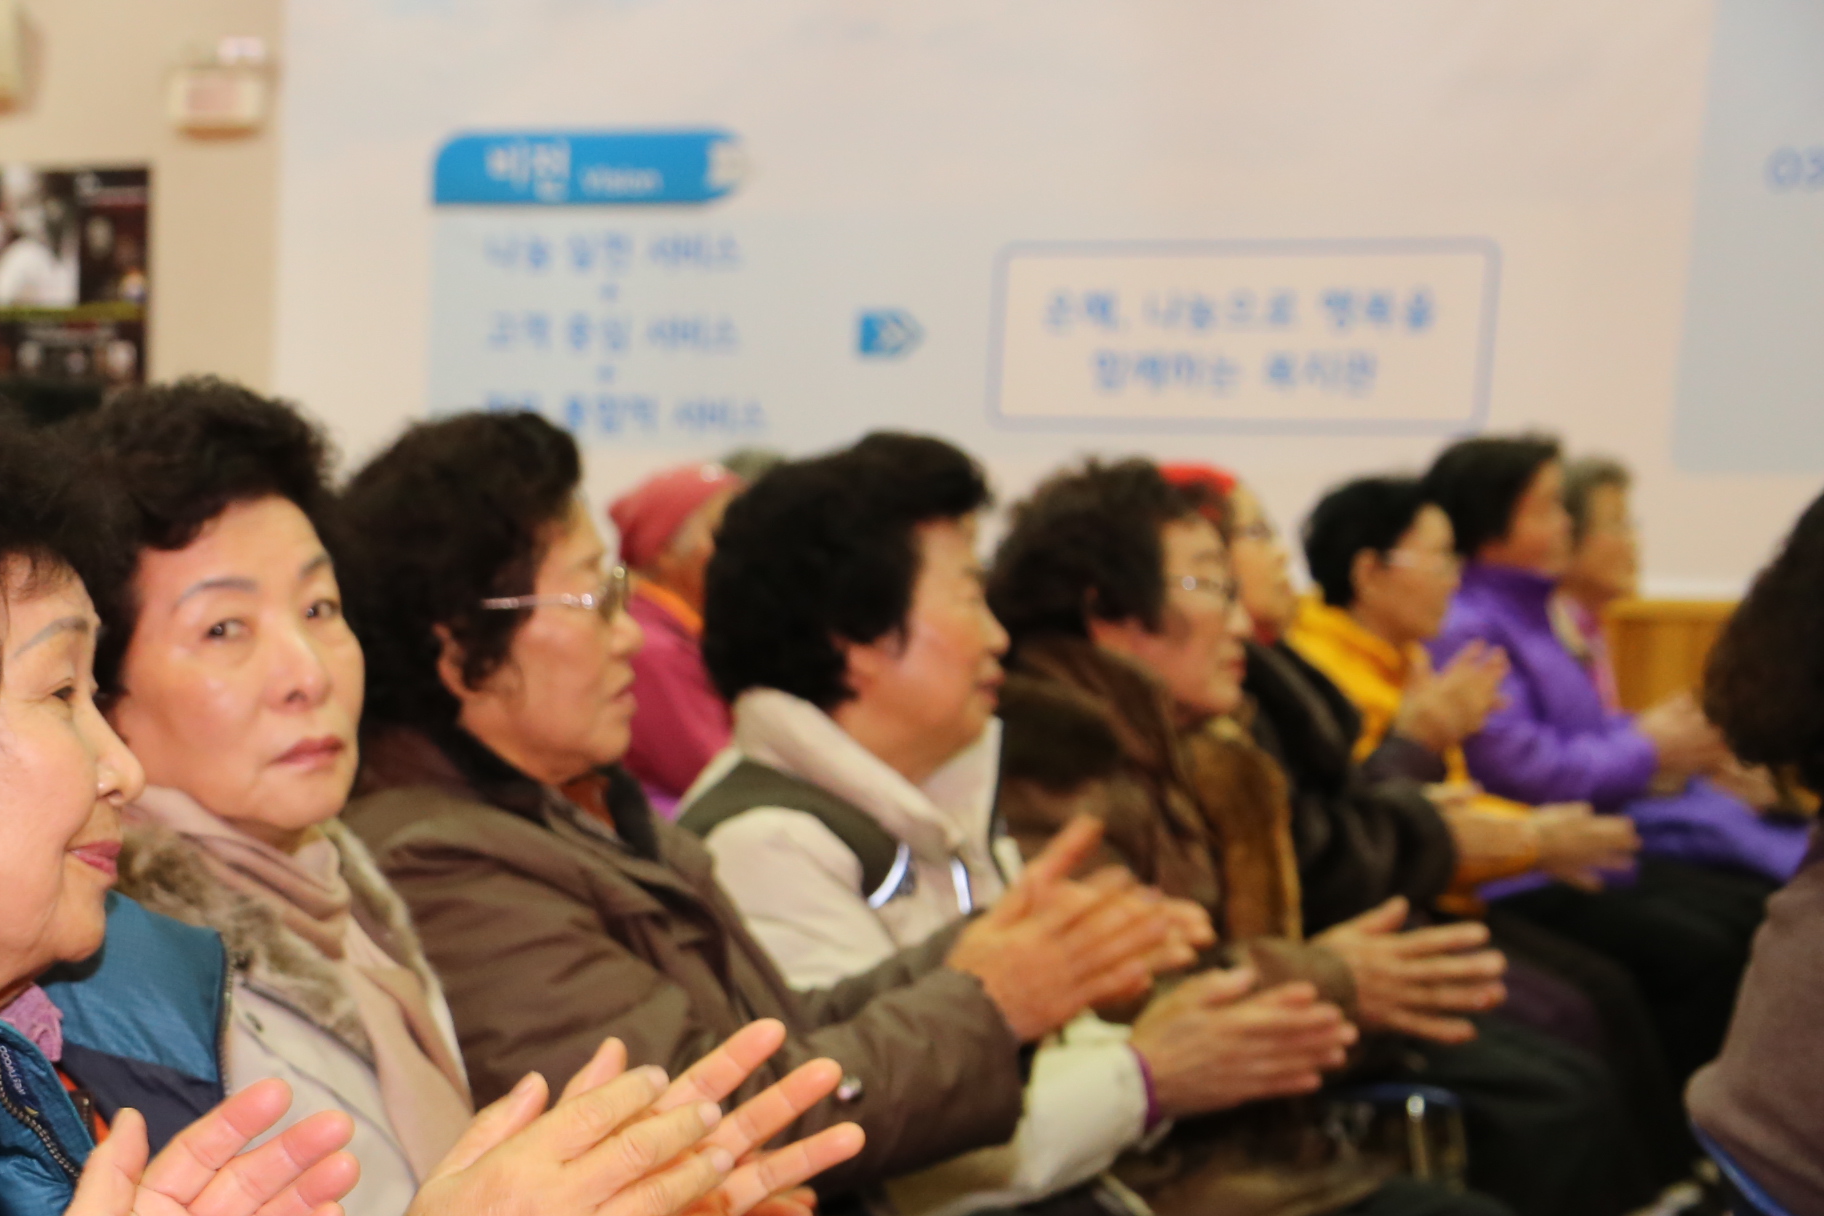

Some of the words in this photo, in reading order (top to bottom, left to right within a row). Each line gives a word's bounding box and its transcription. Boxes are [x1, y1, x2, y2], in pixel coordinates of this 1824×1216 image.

[485, 142, 571, 202] 비전
[648, 235, 742, 271] 서비스
[647, 315, 739, 350] 서비스
